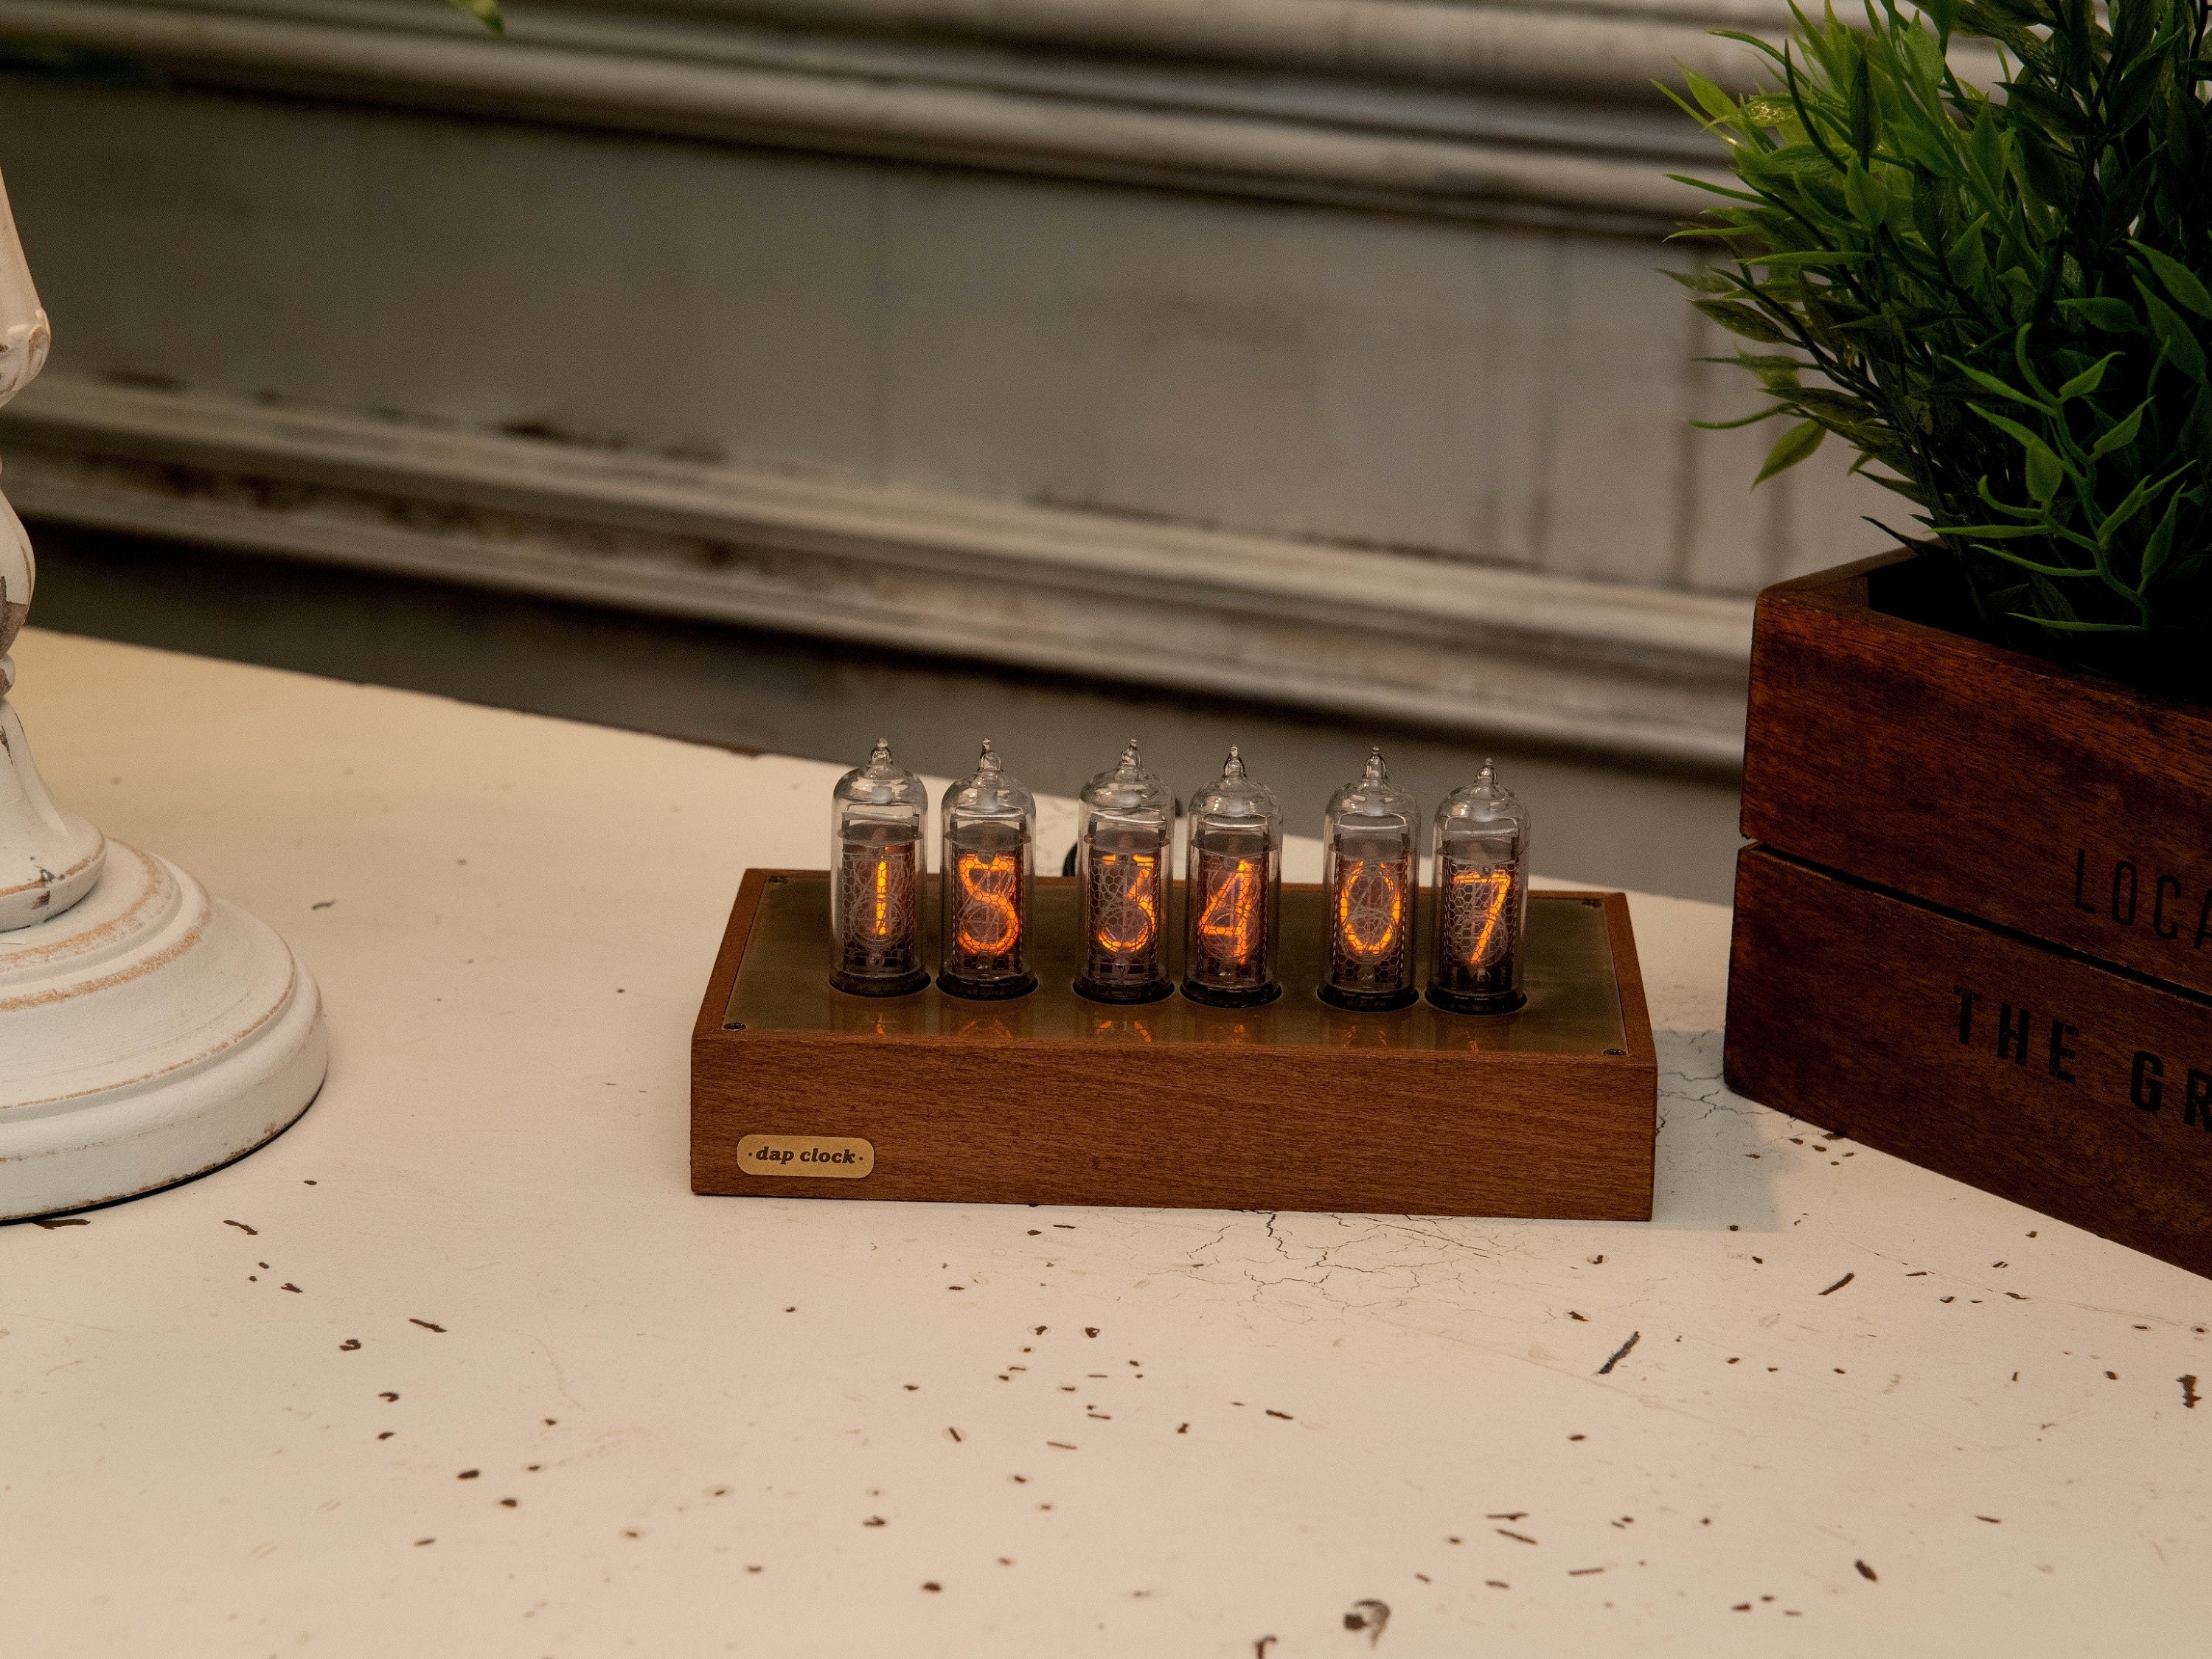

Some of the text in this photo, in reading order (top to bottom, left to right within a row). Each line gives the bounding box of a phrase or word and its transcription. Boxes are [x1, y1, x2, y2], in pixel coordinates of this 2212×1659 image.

[1953, 984, 2212, 1133] THE GR
[756, 1146, 856, 1165] dap clock
